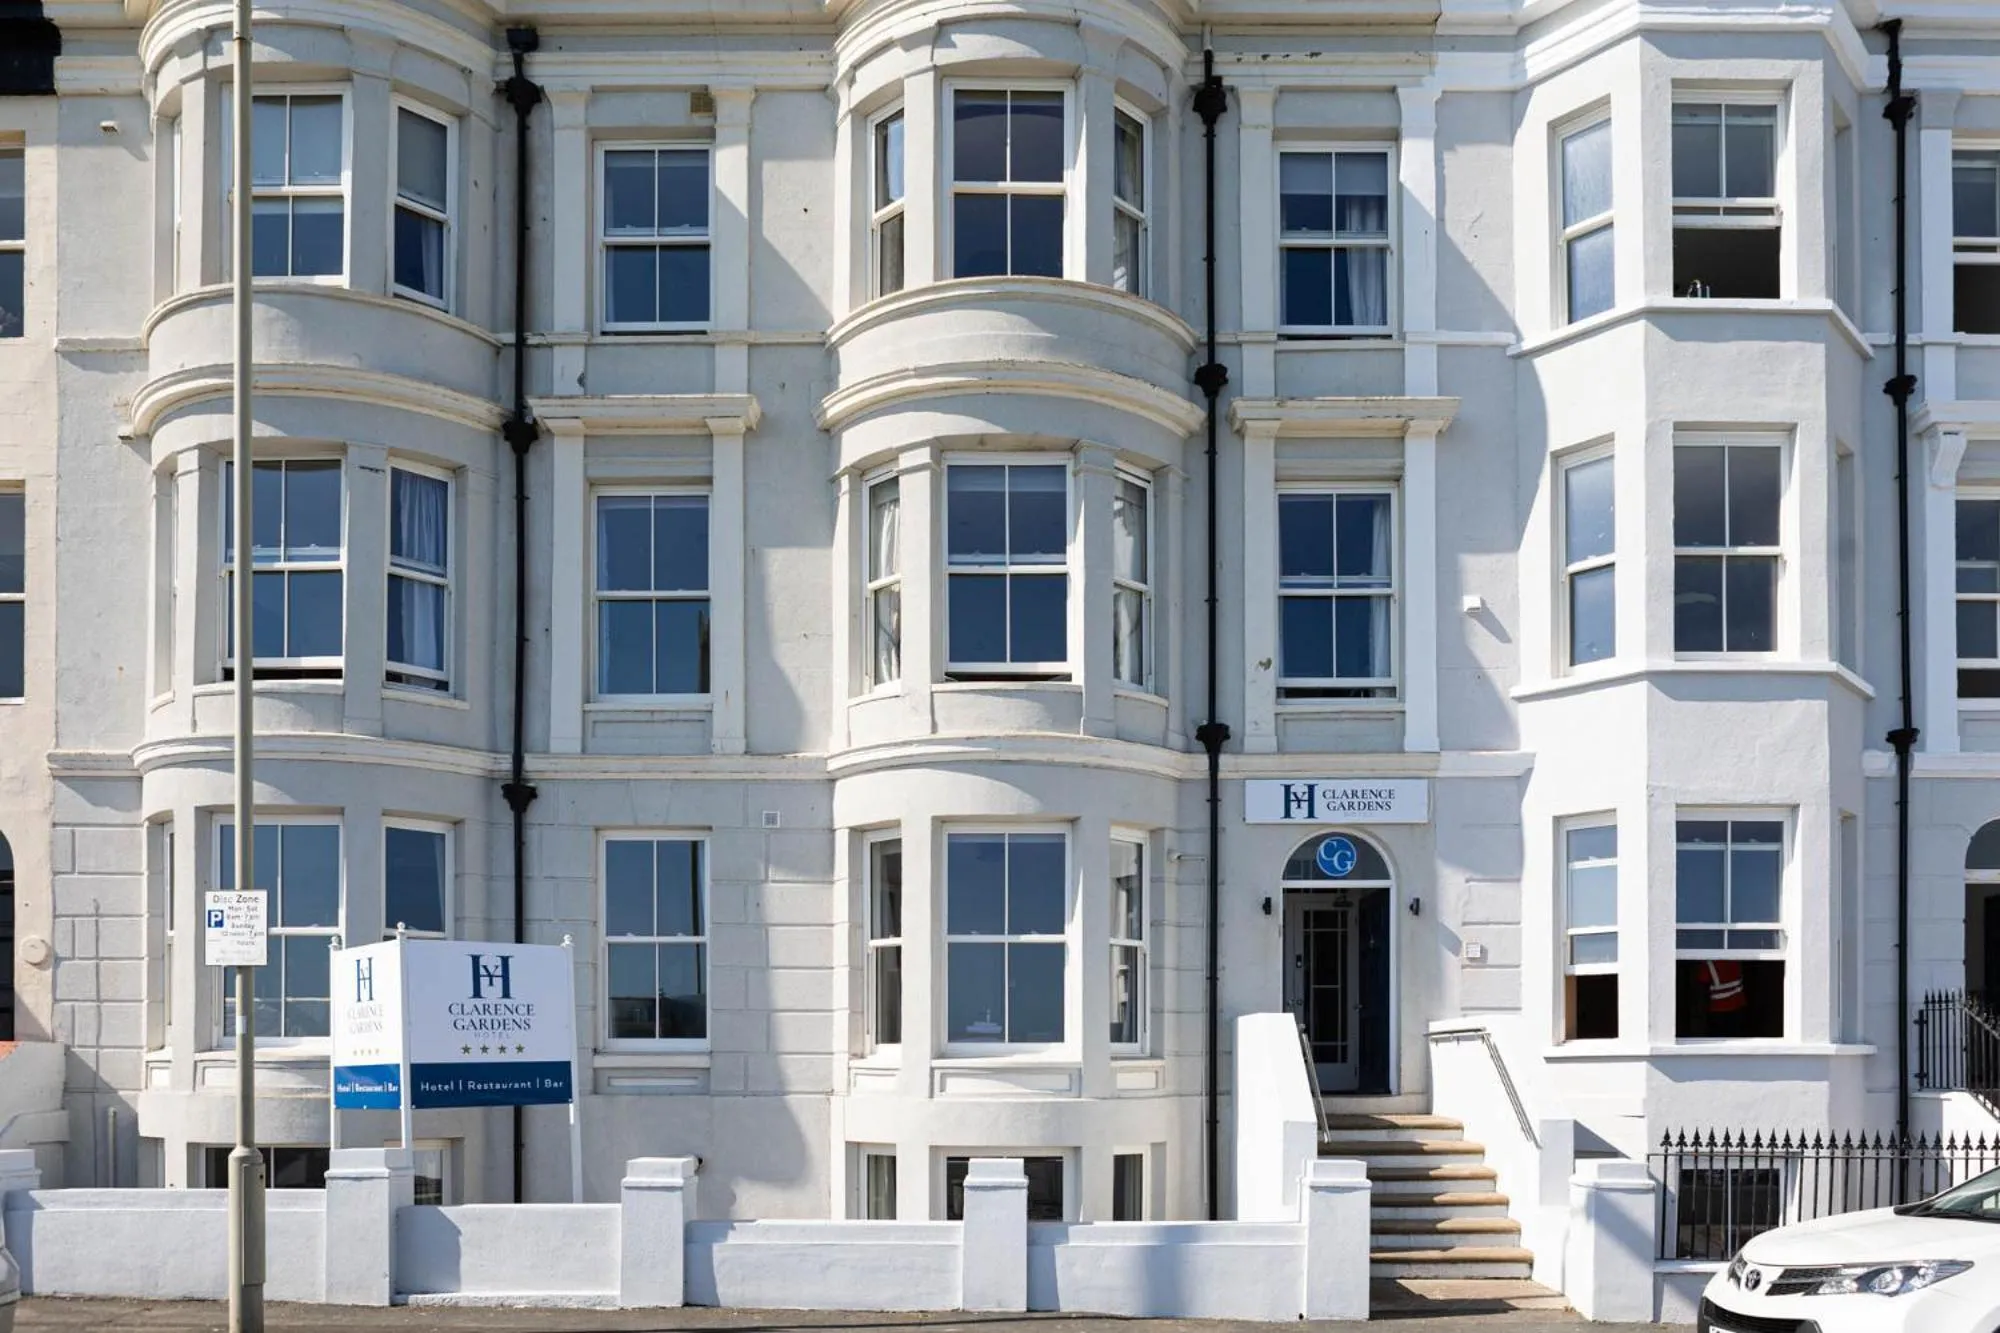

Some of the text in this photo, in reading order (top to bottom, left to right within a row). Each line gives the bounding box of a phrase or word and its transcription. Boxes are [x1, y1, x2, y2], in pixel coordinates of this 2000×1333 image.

[1322, 788, 1396, 800] CLARENCE
[1326, 800, 1393, 812] GARDENS
[236, 894, 259, 904] Zone
[448, 1002, 536, 1017] CLARENCE
[453, 1018, 532, 1032] GARDENS
[420, 1081, 455, 1093] Hotel
[467, 1080, 532, 1091] Restaurant
[544, 1078, 564, 1089] Bar
